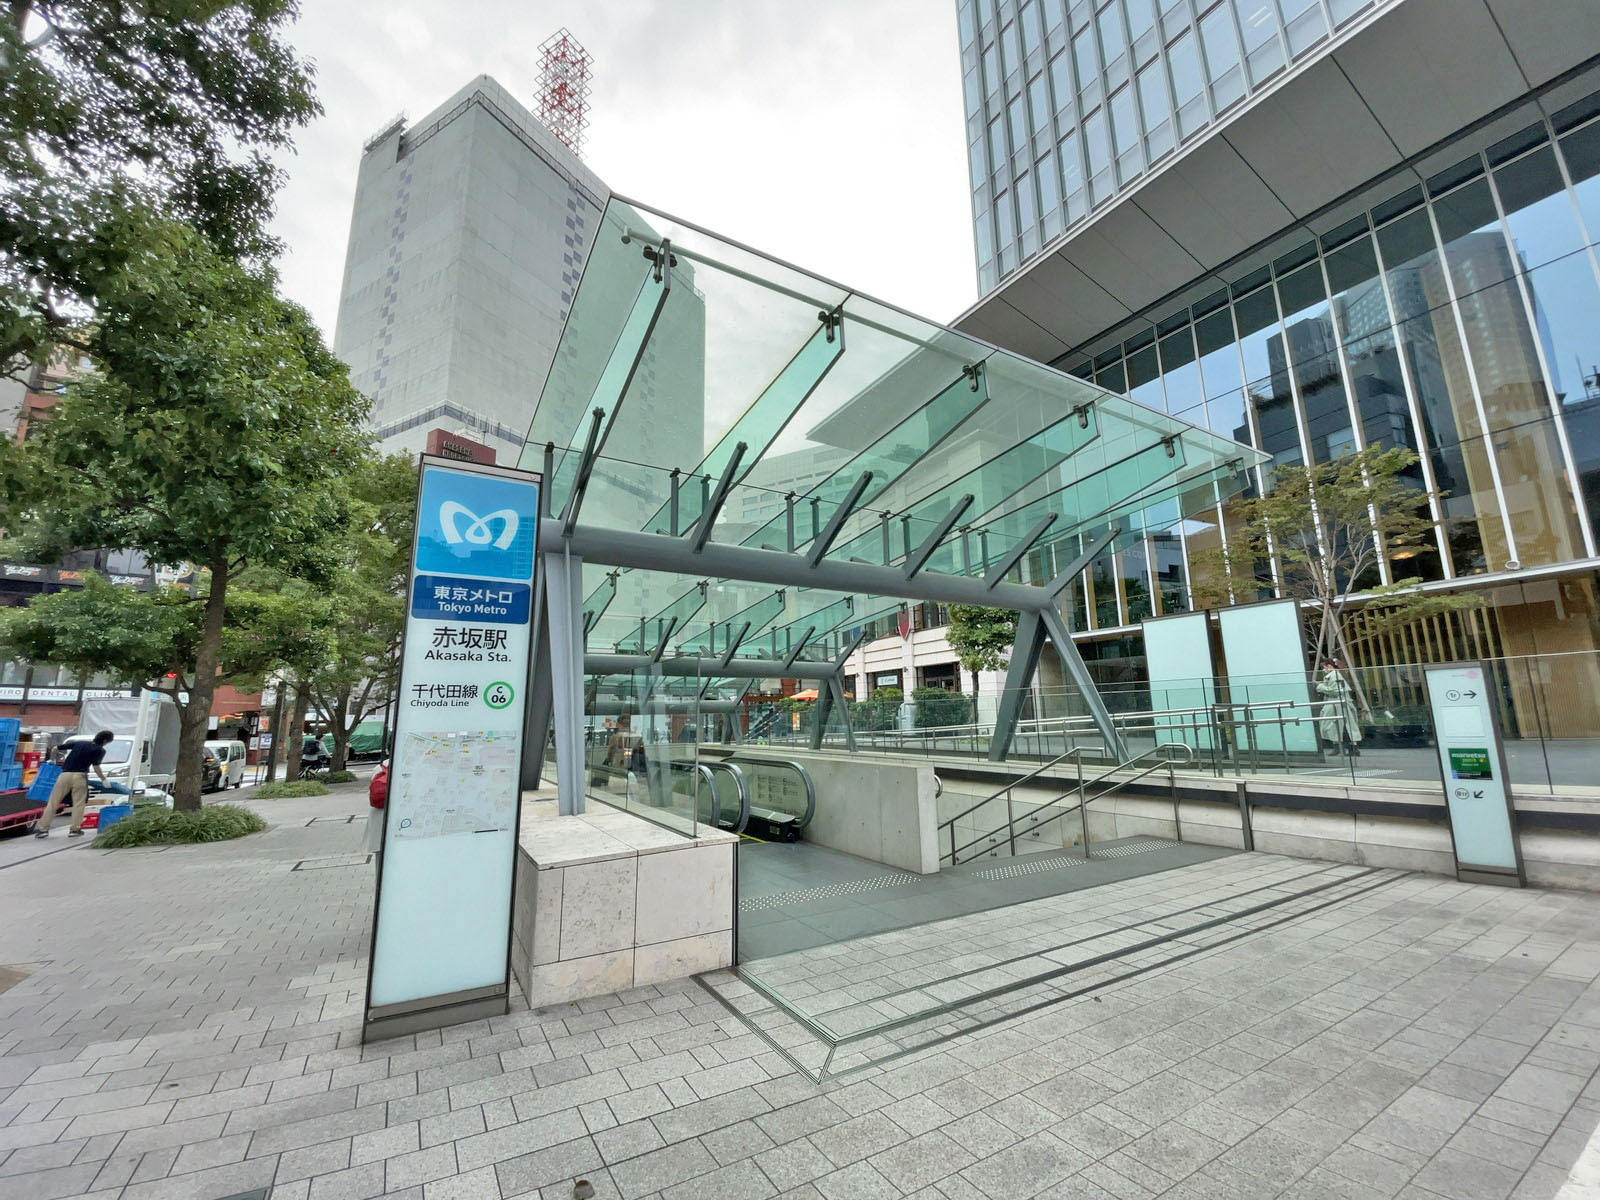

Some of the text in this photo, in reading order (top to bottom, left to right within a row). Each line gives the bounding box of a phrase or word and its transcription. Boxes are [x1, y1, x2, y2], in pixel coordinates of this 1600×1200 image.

[433, 585, 513, 604] 東京メトロ
[438, 601, 507, 615] Tokyo Metro
[432, 626, 507, 650] 赤坂駅
[424, 650, 512, 662] Akasaka Sta.
[411, 684, 479, 699] 千代田線
[496, 686, 503, 694] C
[410, 699, 470, 709] Chiyoda Line
[491, 695, 507, 703] 06
